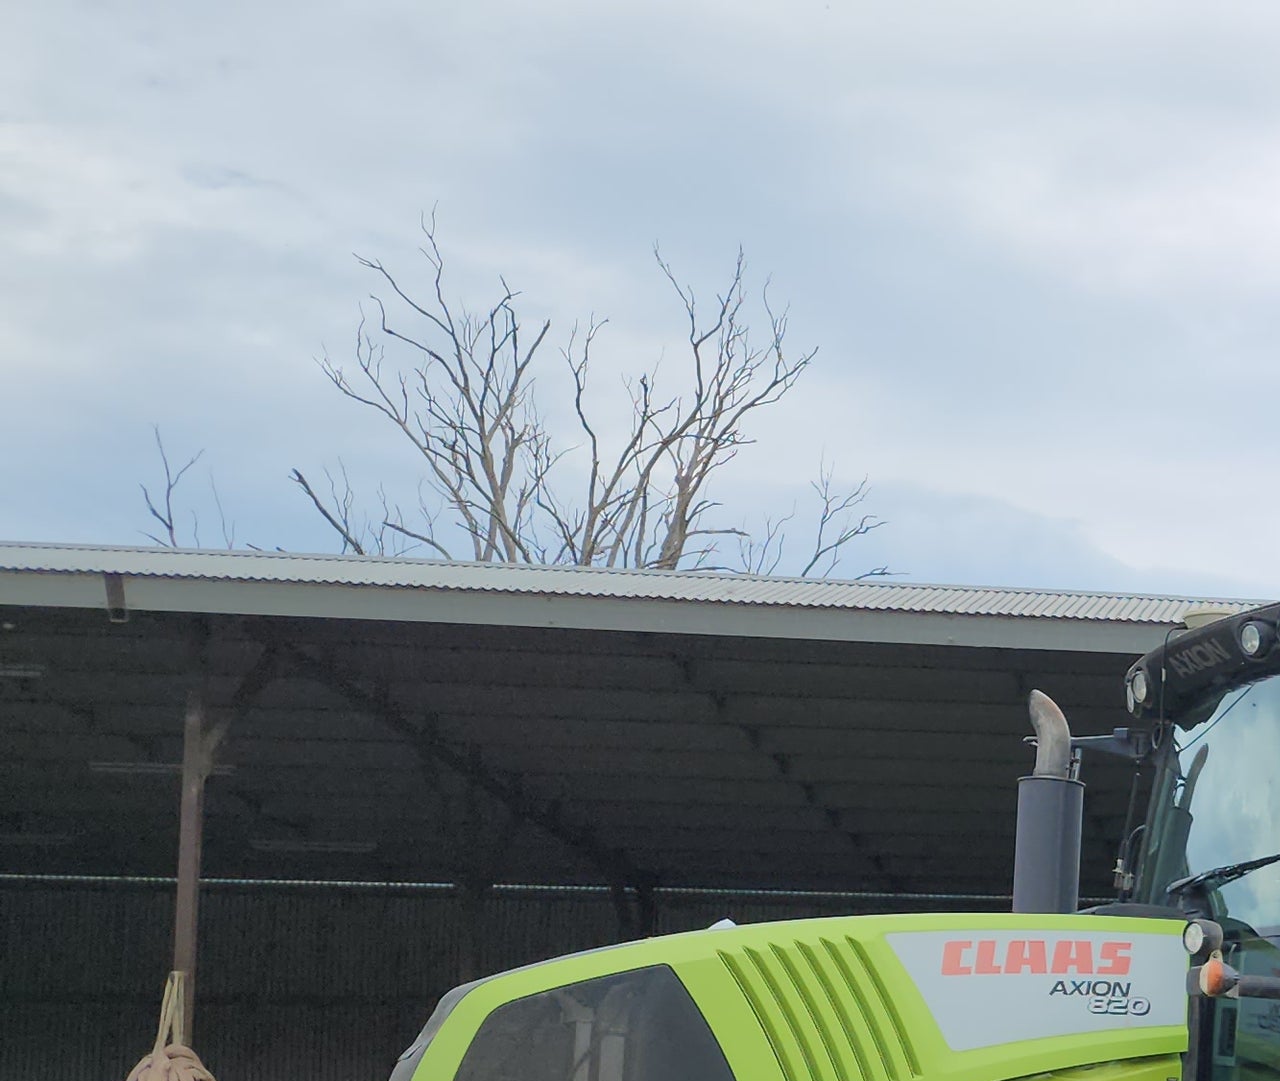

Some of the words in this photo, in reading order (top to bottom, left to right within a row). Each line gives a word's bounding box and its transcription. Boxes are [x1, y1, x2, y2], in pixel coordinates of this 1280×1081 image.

[1168, 637, 1231, 679] AXION
[941, 940, 1132, 976] CLAAS
[1049, 980, 1131, 996] AXION
[1087, 997, 1151, 1016] 820
